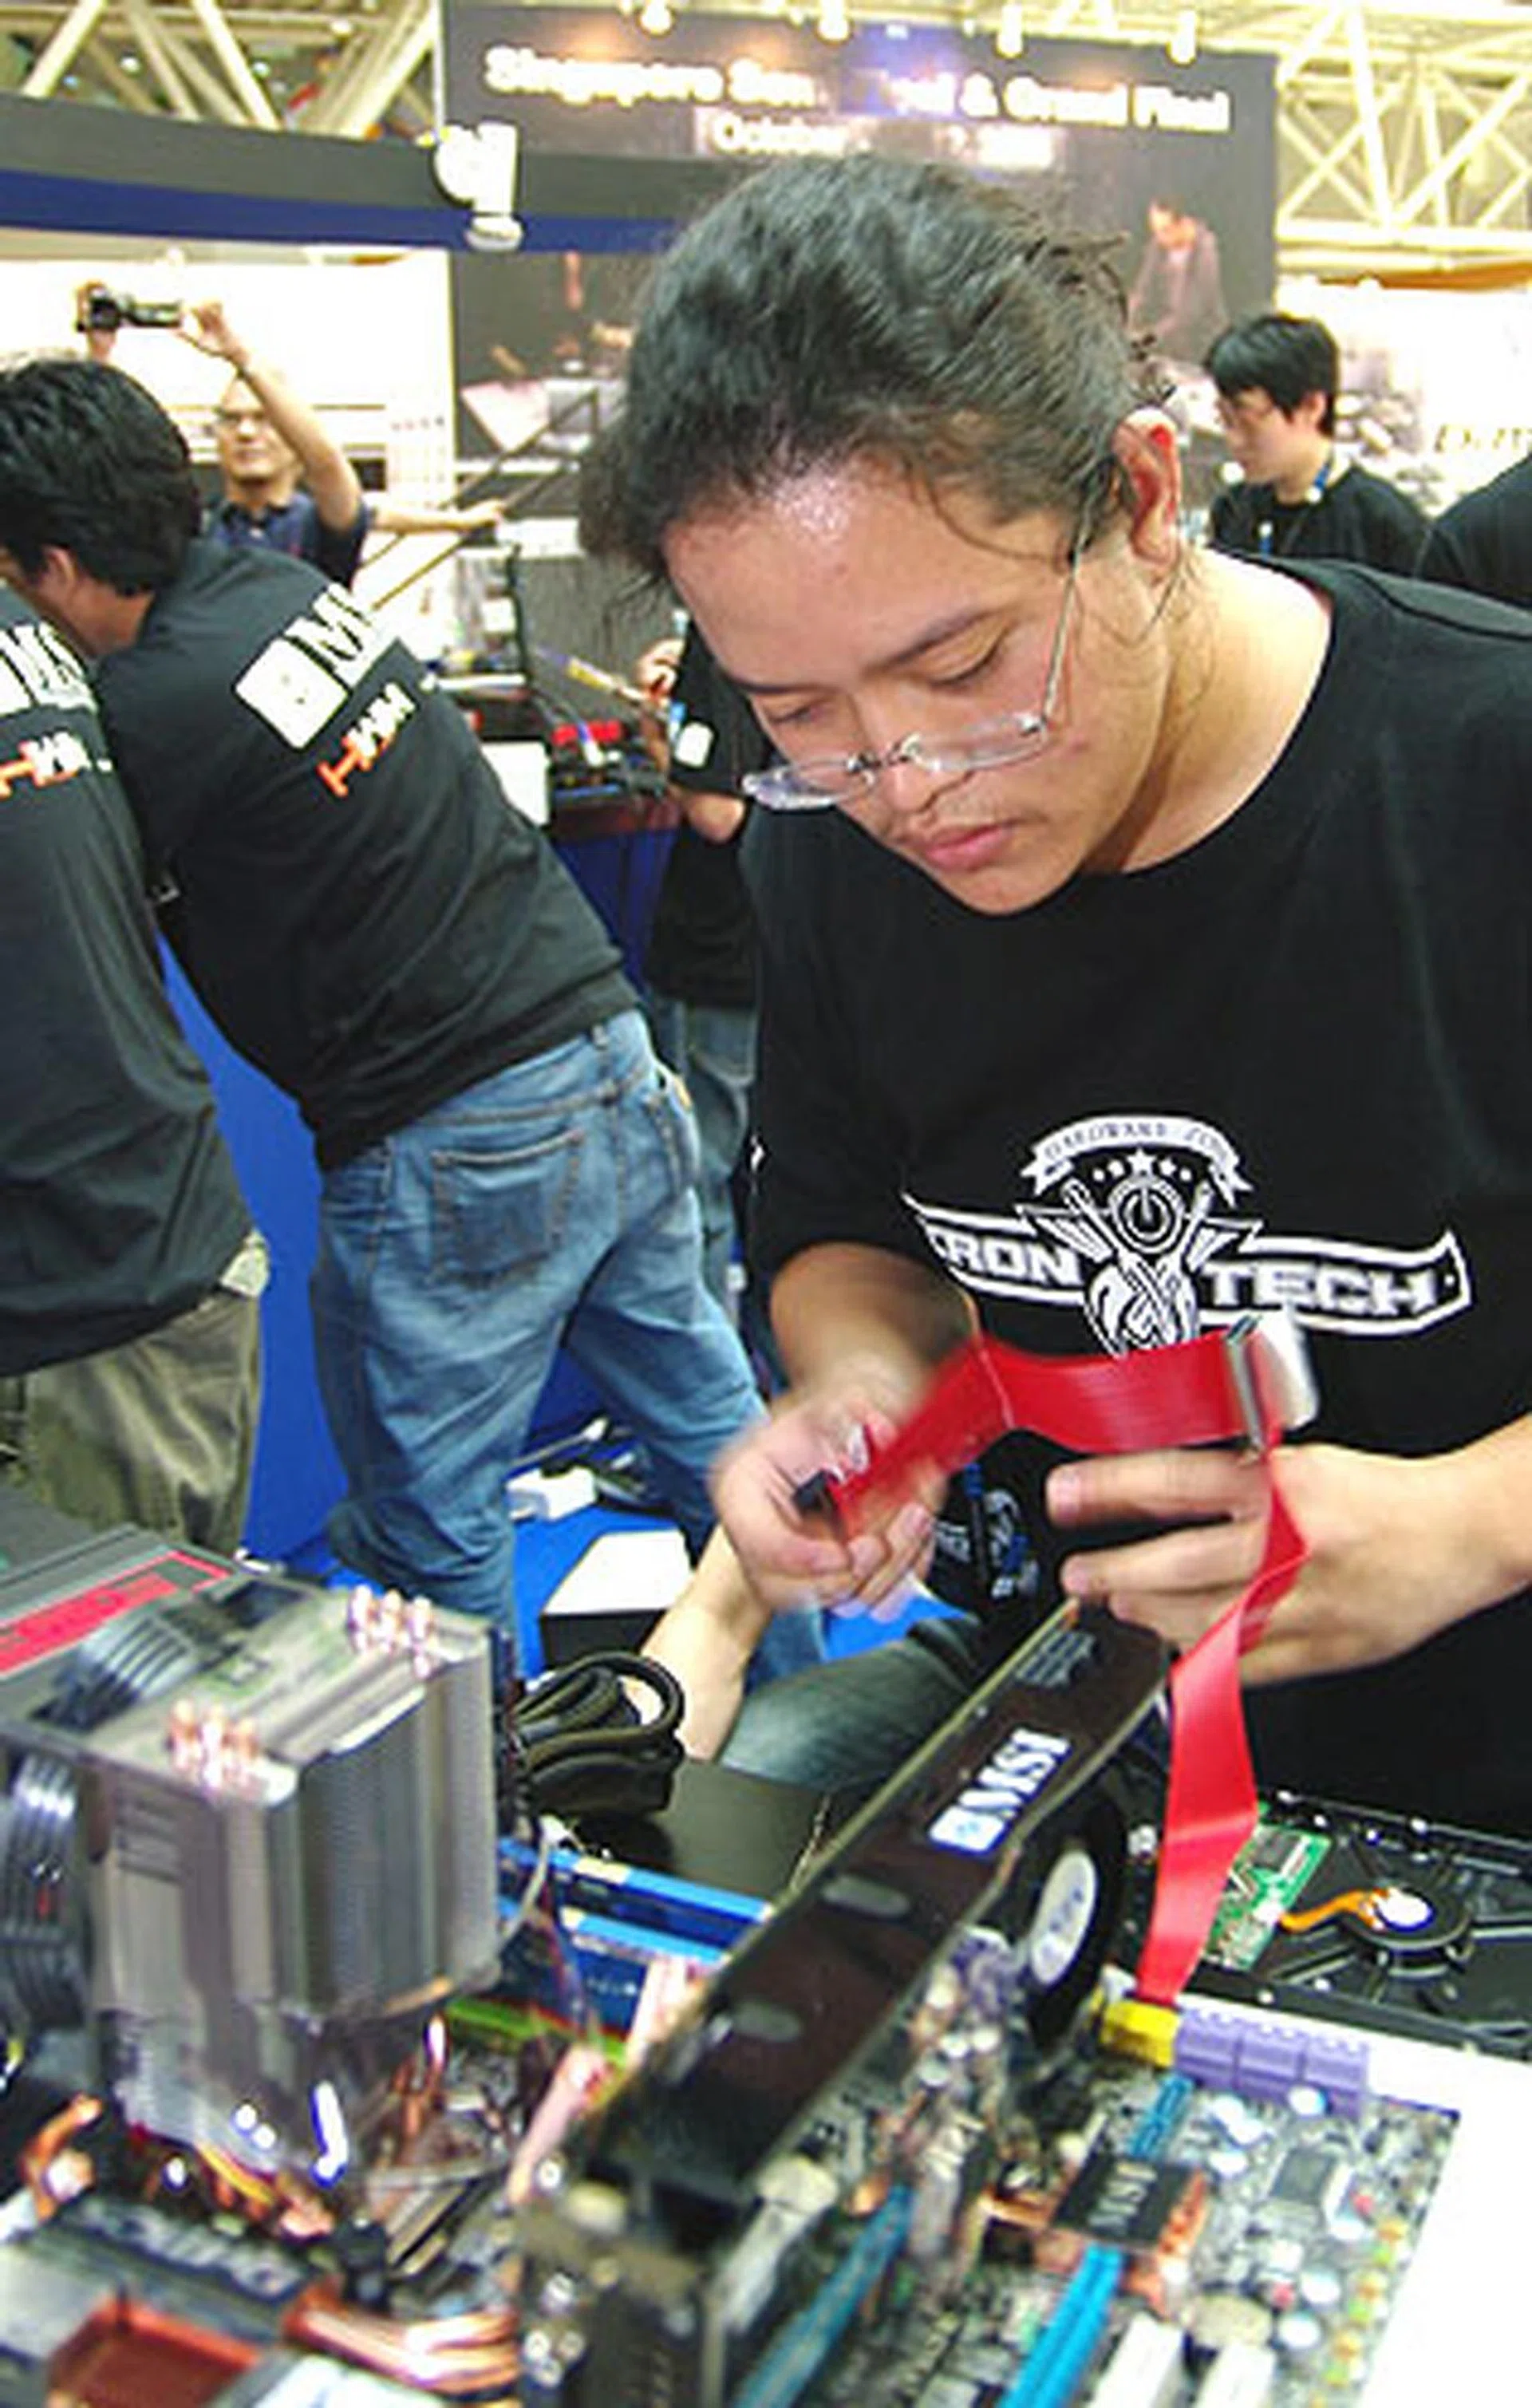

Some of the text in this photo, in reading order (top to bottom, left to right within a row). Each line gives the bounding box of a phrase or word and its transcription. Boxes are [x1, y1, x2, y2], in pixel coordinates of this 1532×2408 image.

[485, 45, 723, 107] Singapore
[1201, 1260, 1436, 1317] TECH
[960, 1728, 1070, 1818] MSI
